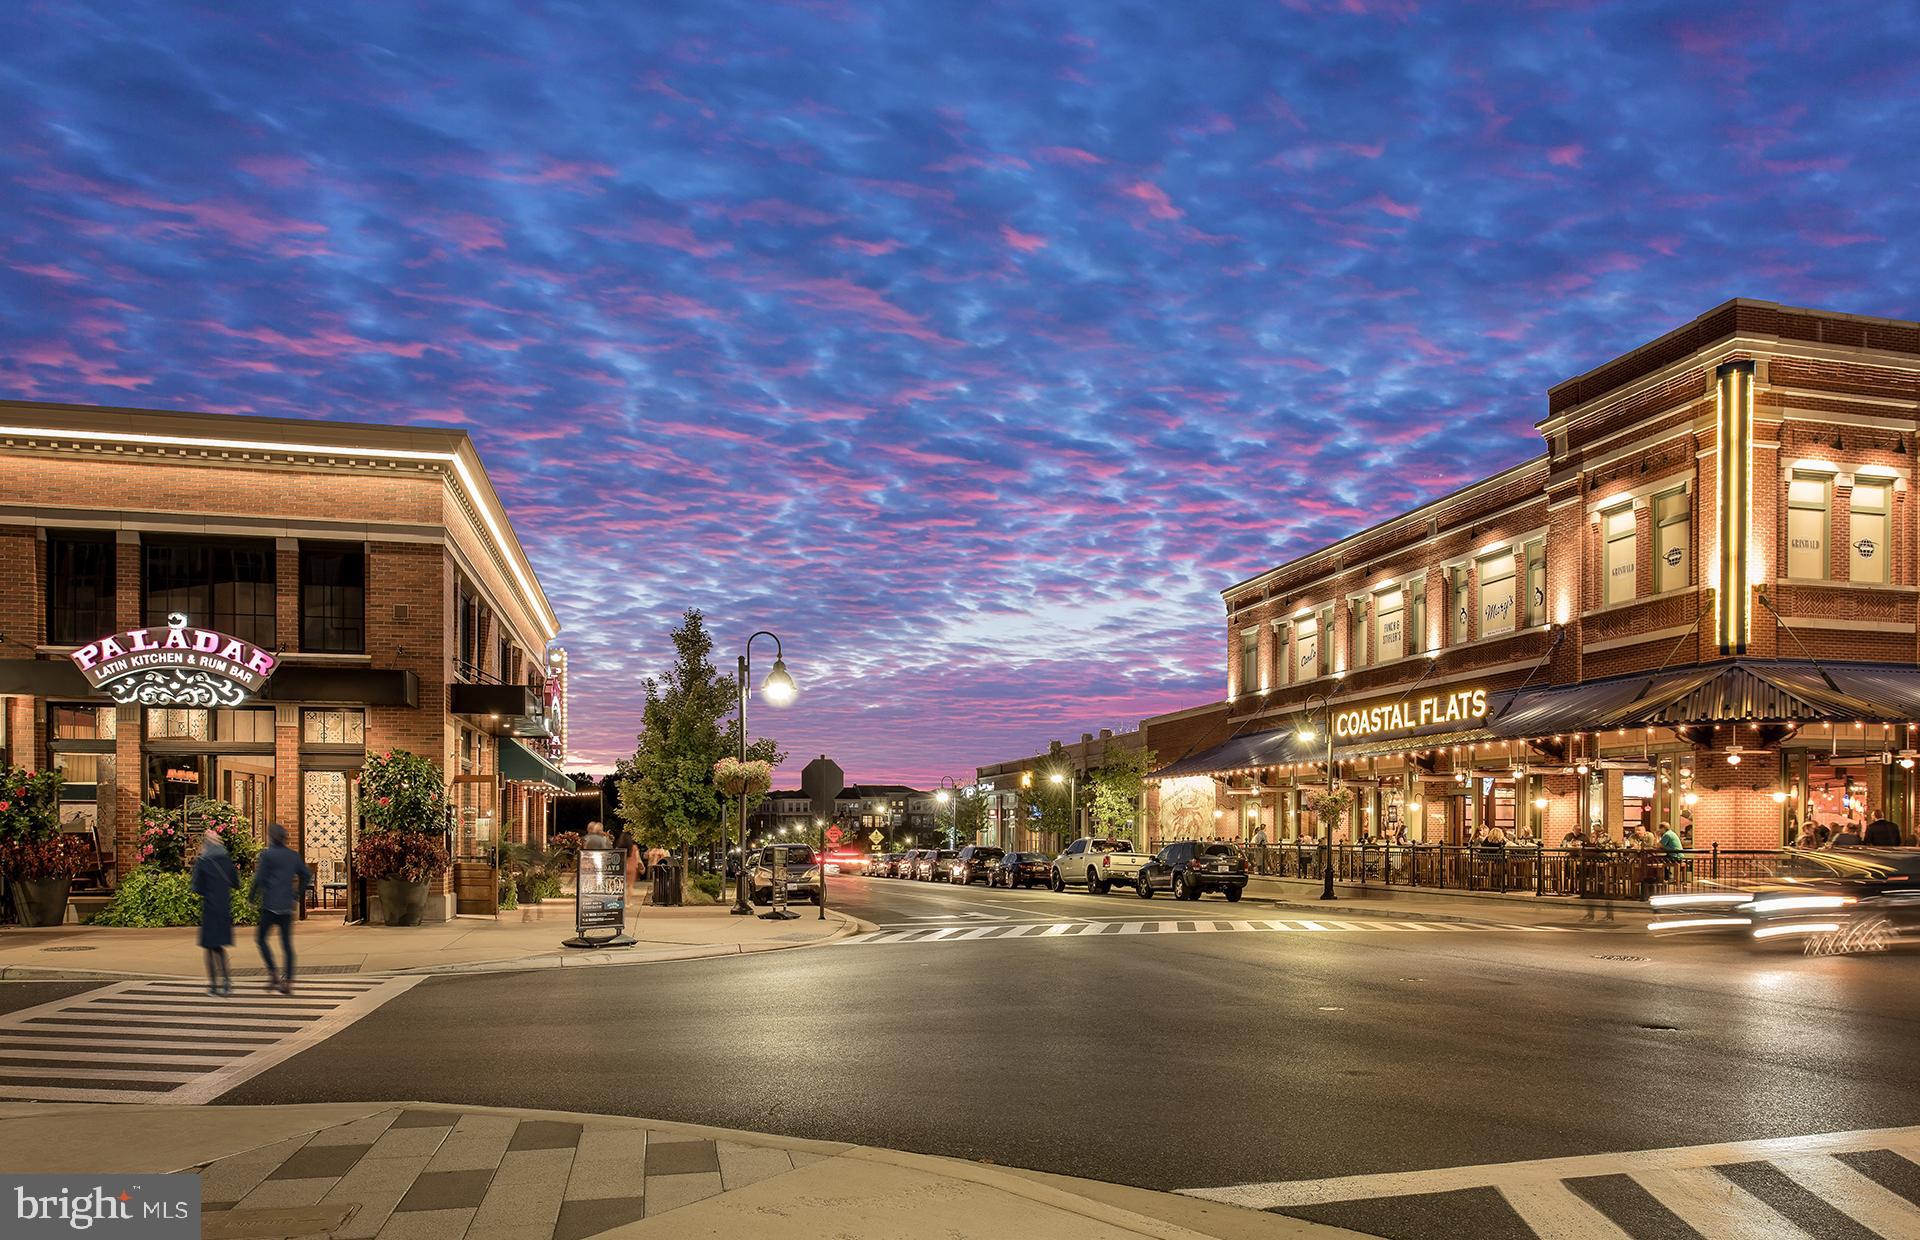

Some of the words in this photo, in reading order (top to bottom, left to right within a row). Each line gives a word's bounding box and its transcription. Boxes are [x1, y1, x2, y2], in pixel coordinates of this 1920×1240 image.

[1485, 594, 1514, 621] Mary's
[71, 628, 275, 676] PALADAR
[95, 660, 128, 679] LATIN
[131, 653, 183, 666] KITCHEN
[187, 654, 196, 665] &
[199, 656, 227, 672] RUM
[229, 666, 254, 683] BAR
[1336, 702, 1416, 737] COASTAL
[1420, 690, 1487, 725] FLATS
